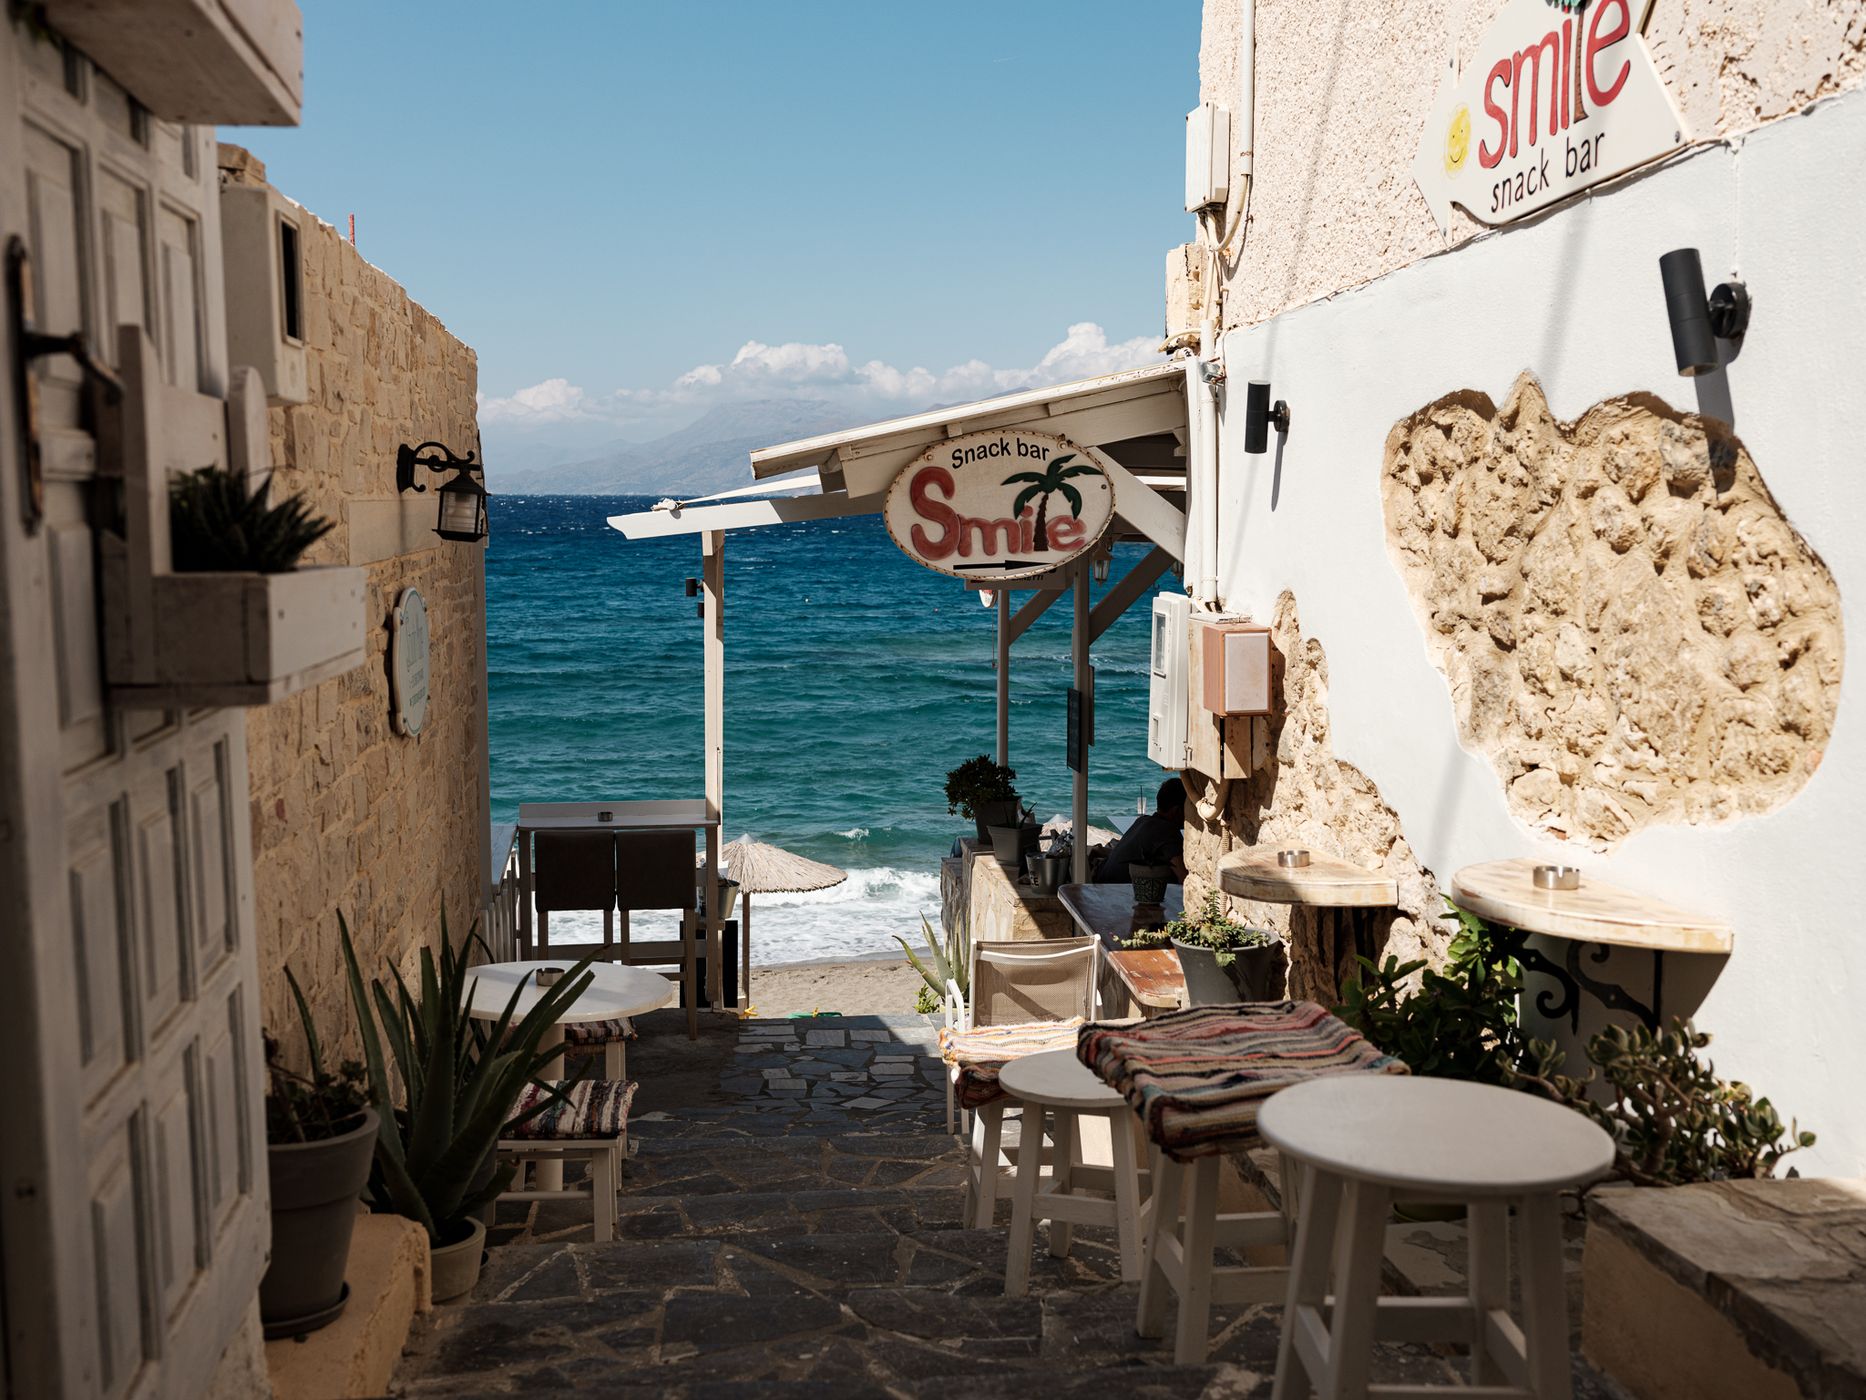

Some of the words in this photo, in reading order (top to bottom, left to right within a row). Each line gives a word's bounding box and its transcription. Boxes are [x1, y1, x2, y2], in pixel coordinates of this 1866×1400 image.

[1479, 0, 1631, 169] smile
[1491, 147, 1549, 213] snack
[1565, 132, 1605, 178] bar
[951, 437, 1011, 469] Snack
[1016, 437, 1050, 461] bar
[910, 466, 1087, 561] Smile
